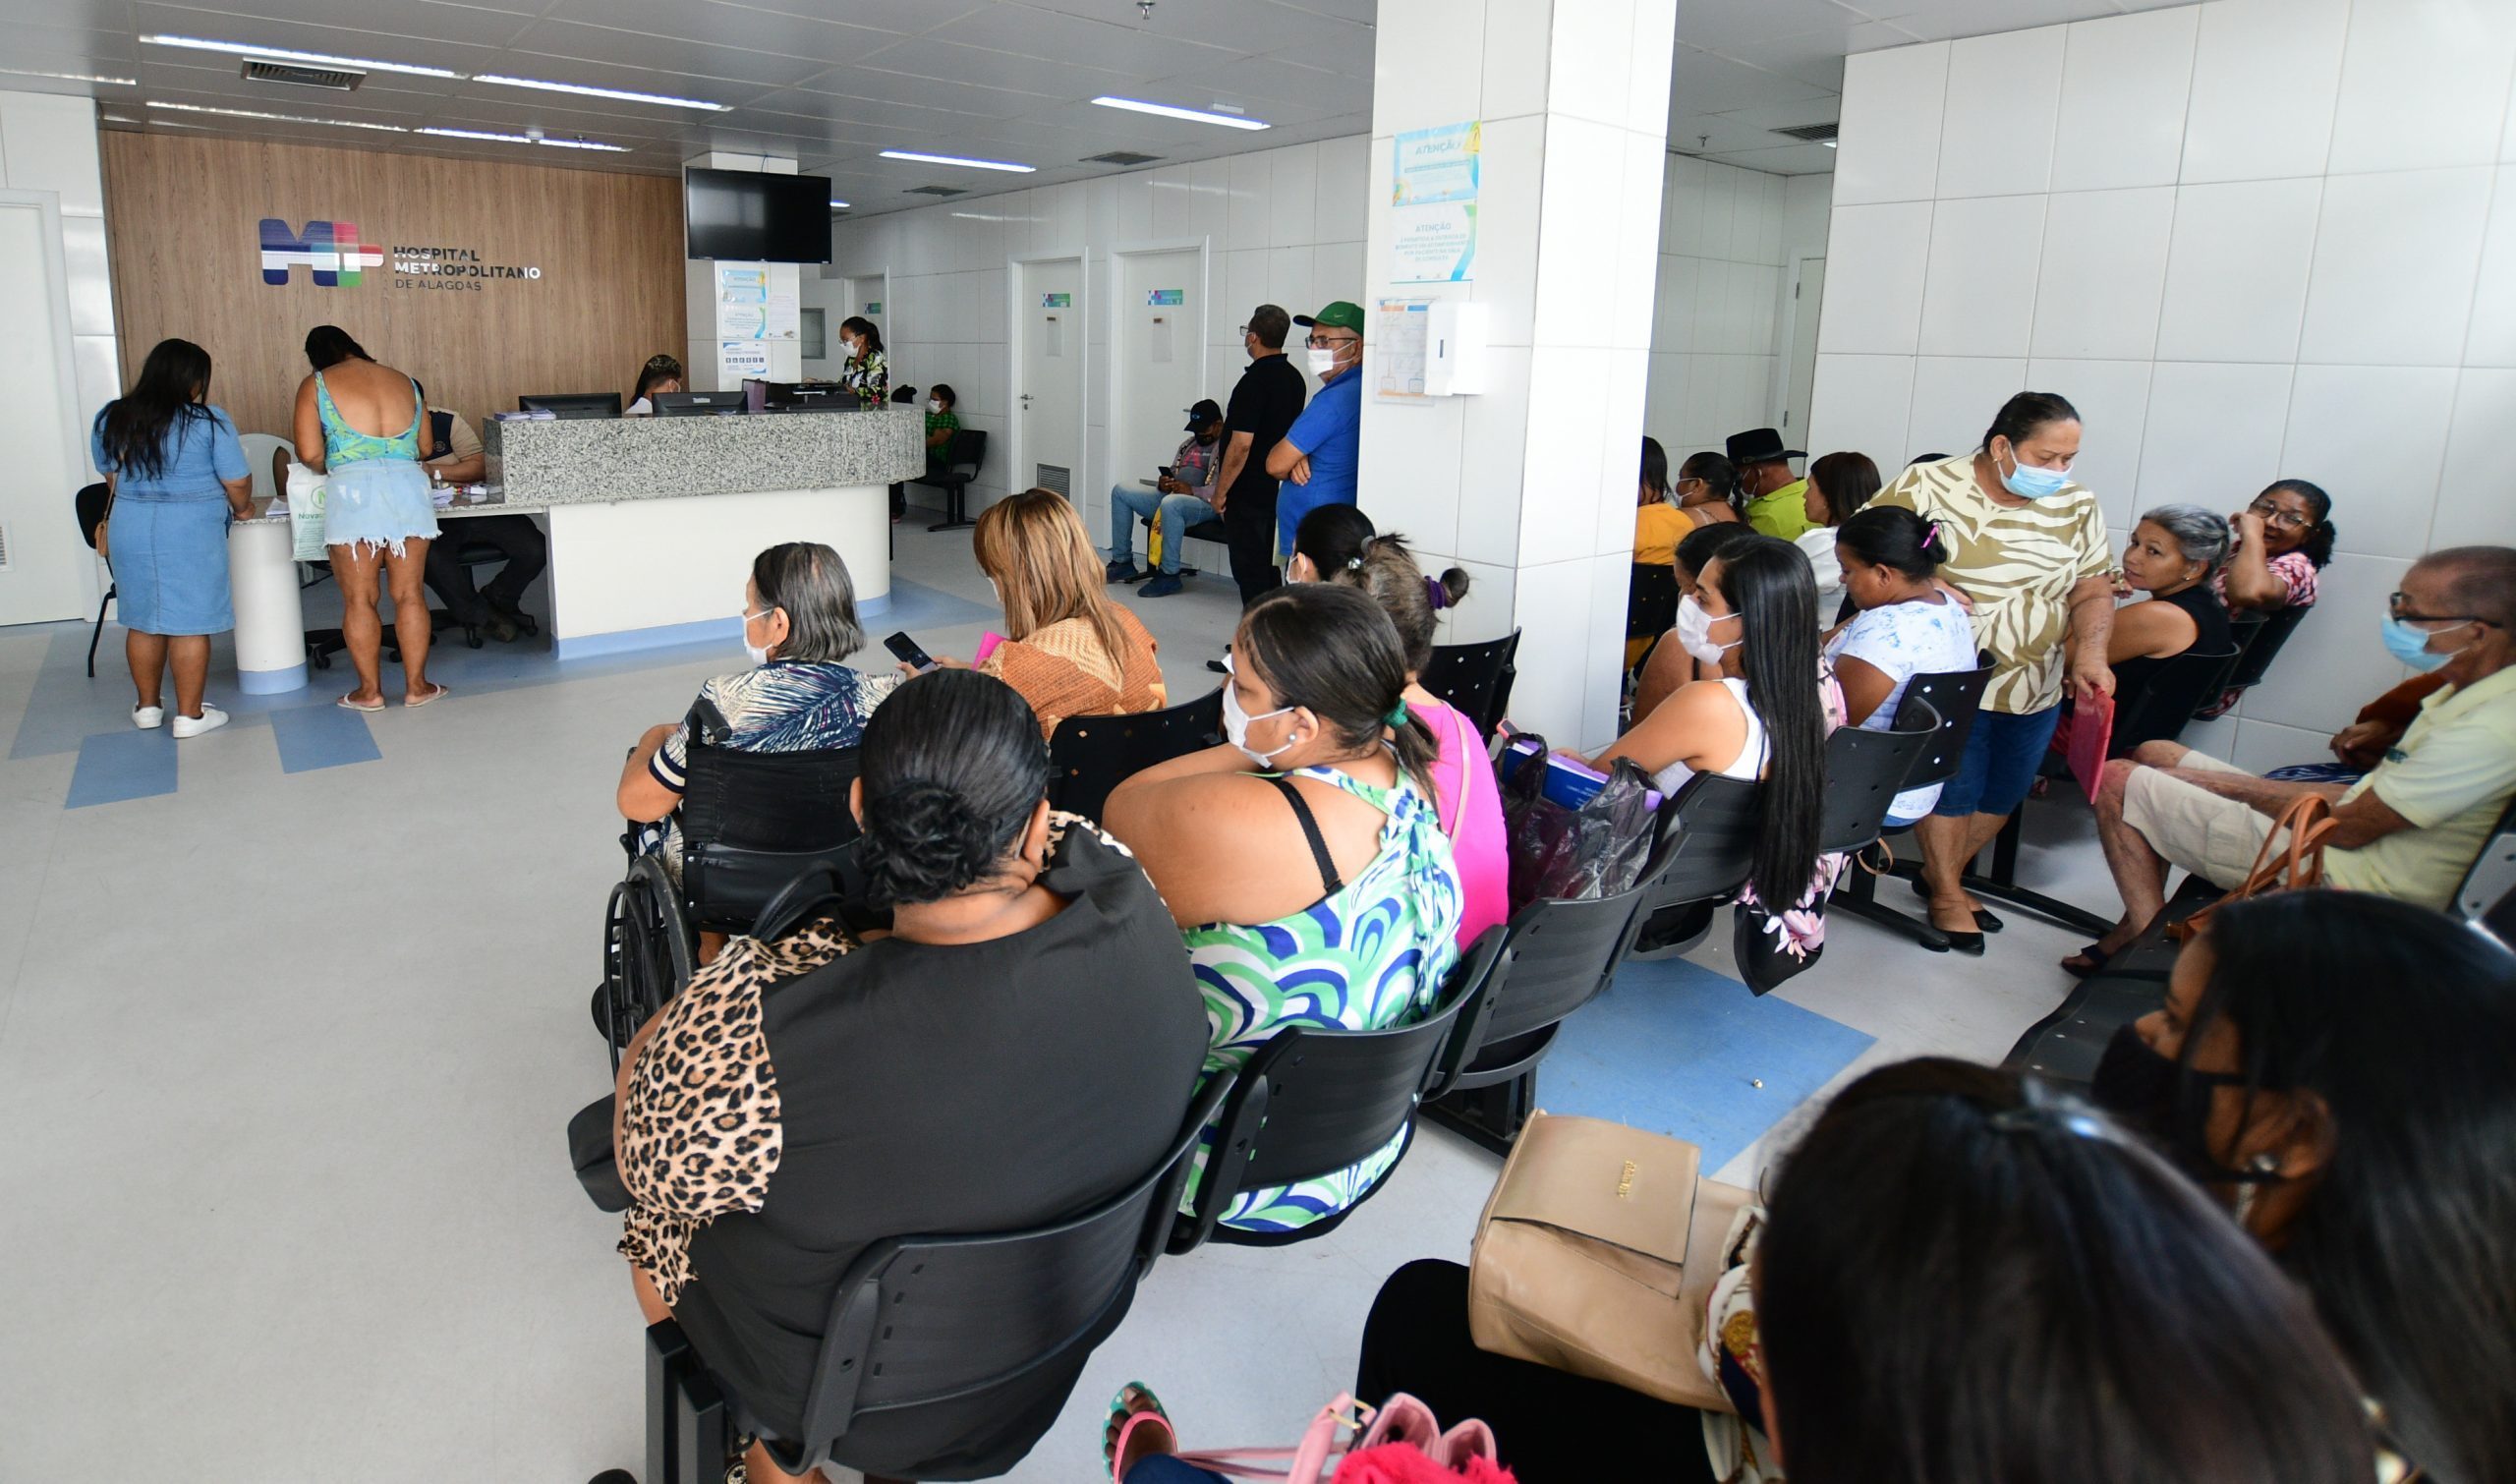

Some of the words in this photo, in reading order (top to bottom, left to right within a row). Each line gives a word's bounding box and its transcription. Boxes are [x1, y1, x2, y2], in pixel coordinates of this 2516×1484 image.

[1415, 221, 1452, 235] ATENÇÃO
[393, 247, 480, 261] HOSPITAL
[394, 261, 541, 279] METROPOLITANO
[395, 279, 414, 289] DE
[418, 280, 482, 292] ALAGOAS
